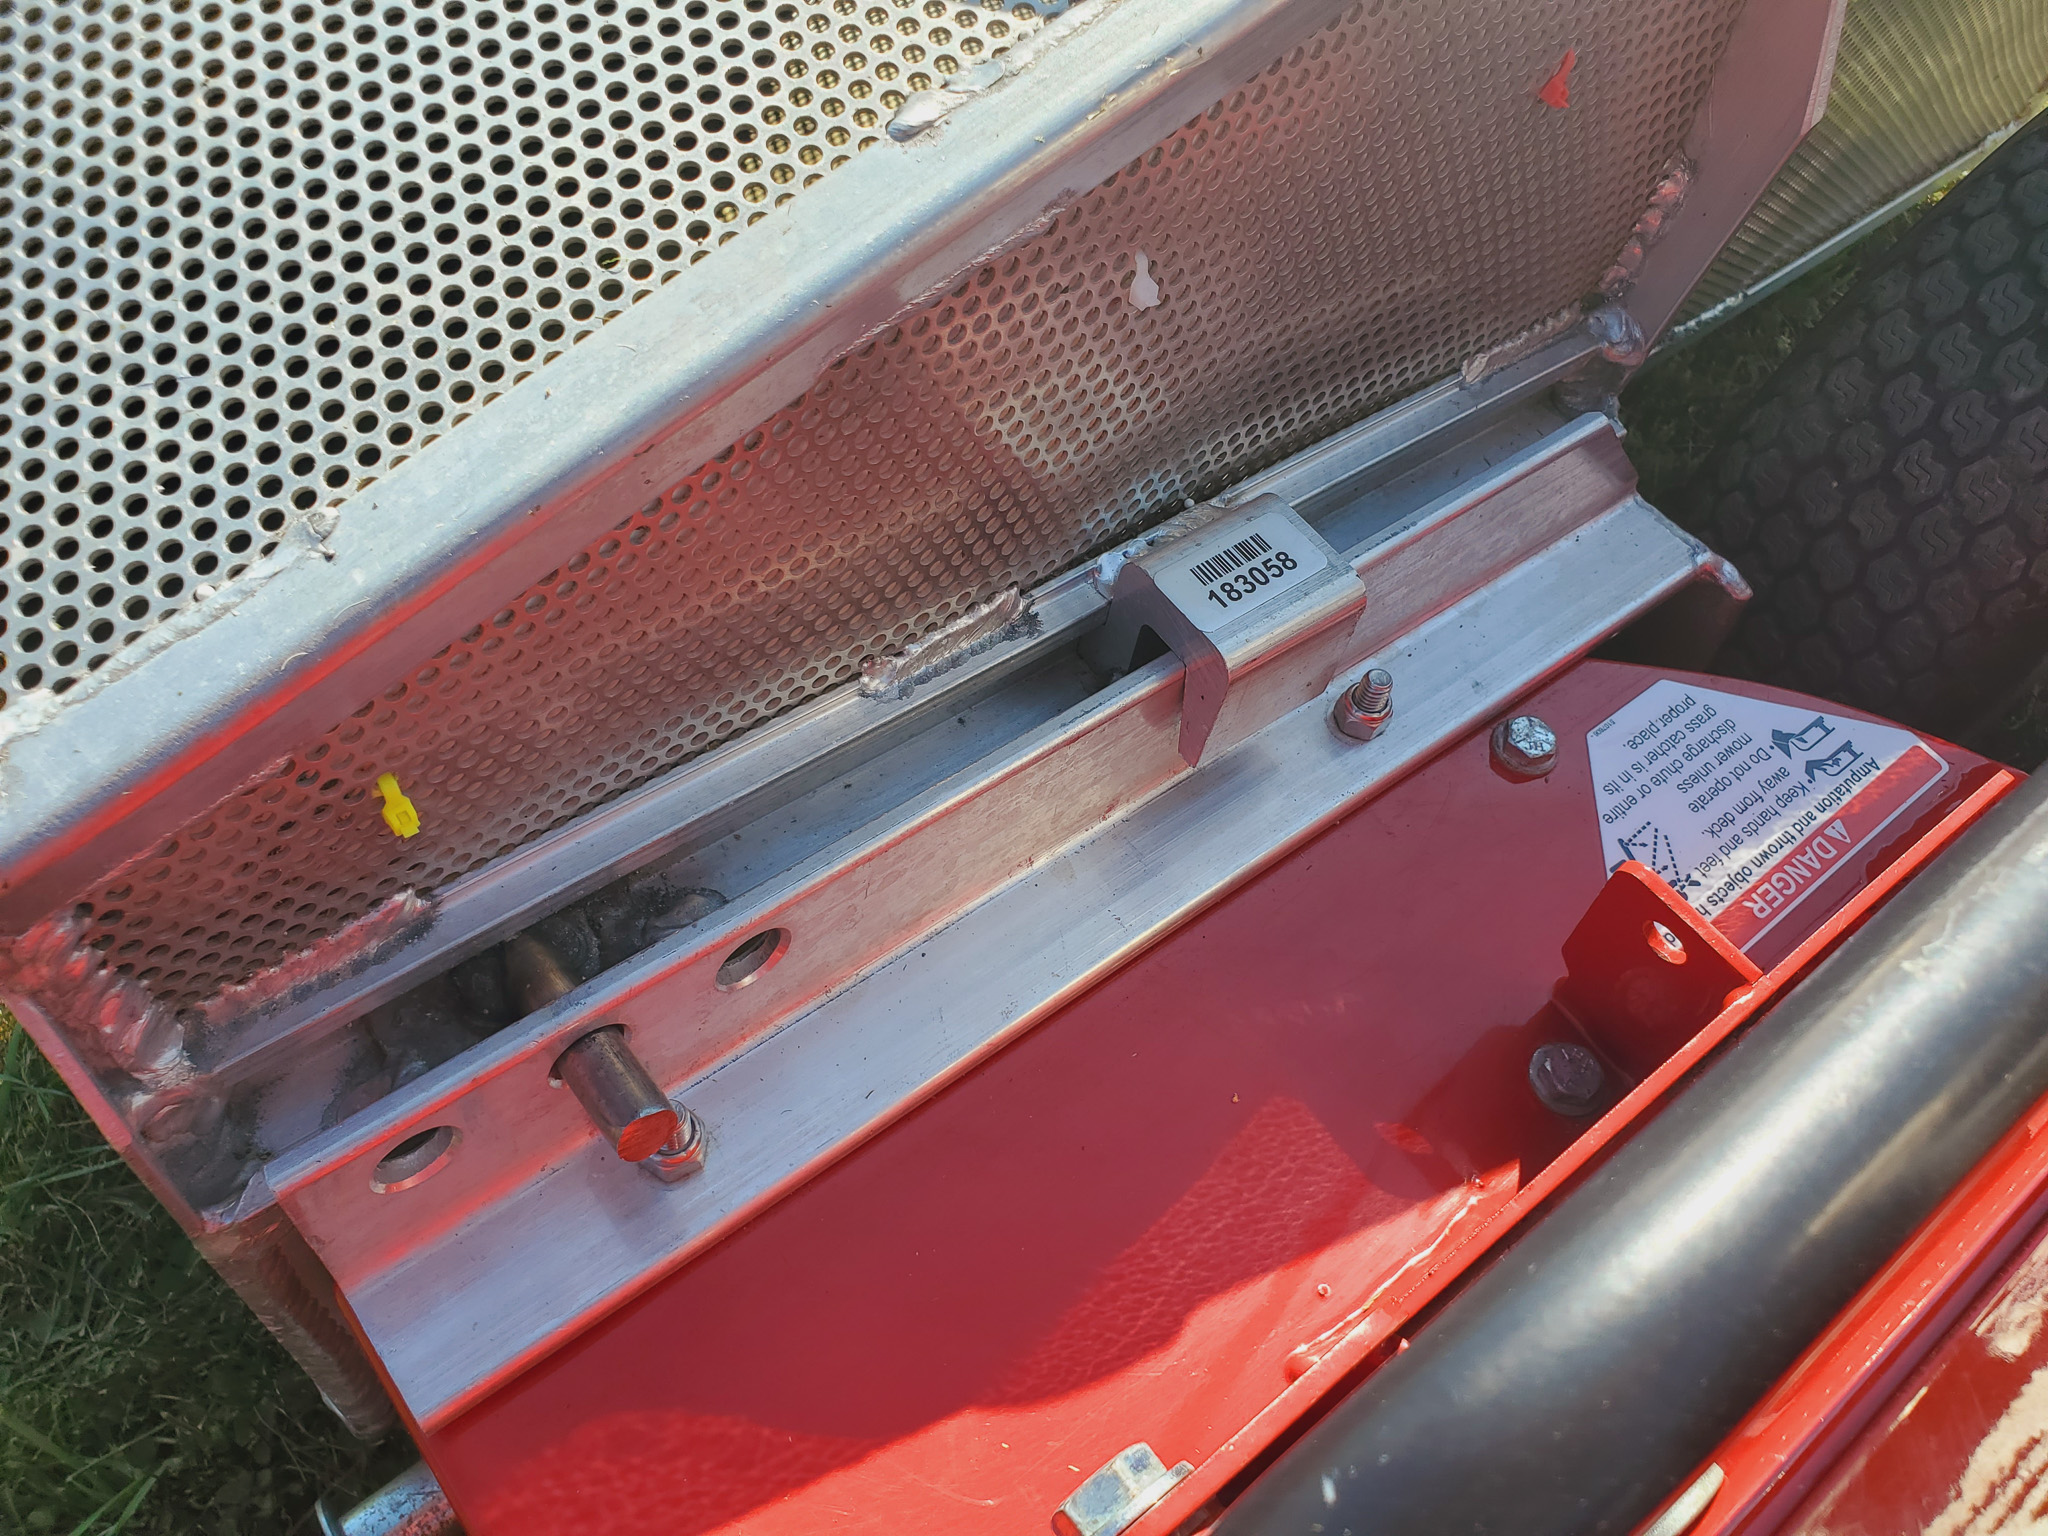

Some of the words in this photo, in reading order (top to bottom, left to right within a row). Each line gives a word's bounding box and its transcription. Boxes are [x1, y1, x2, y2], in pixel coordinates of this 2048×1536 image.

[1208, 551, 1297, 608] 183058
[1658, 693, 1696, 727] proper
[1684, 704, 1717, 733] grass
[1622, 720, 1660, 750] place.
[1643, 730, 1686, 765] catcher
[1682, 718, 1736, 761] discharge
[1713, 732, 1753, 766] mower
[1631, 761, 1649, 774] is
[1749, 747, 1772, 764] Do
[1617, 770, 1637, 783] in
[1650, 759, 1684, 787] chute
[1676, 761, 1716, 793] unless
[1729, 760, 1751, 782] not
[1757, 766, 1790, 794] away
[1815, 757, 1881, 813] Amputation
[1602, 779, 1625, 795] its
[1636, 783, 1652, 798] or
[1688, 776, 1732, 813] operate
[1775, 780, 1811, 809] Keep
[1602, 794, 1638, 824] entire
[1732, 790, 1764, 814] from
[1701, 811, 1735, 838] deck.
[1742, 805, 1781, 837] hands
[1791, 810, 1817, 837] and
[1718, 837, 1744, 860] and
[1750, 830, 1797, 868] thrown
[1694, 852, 1724, 878] feet
[1742, 835, 1838, 919] DANGER
[1706, 866, 1753, 906] objects
